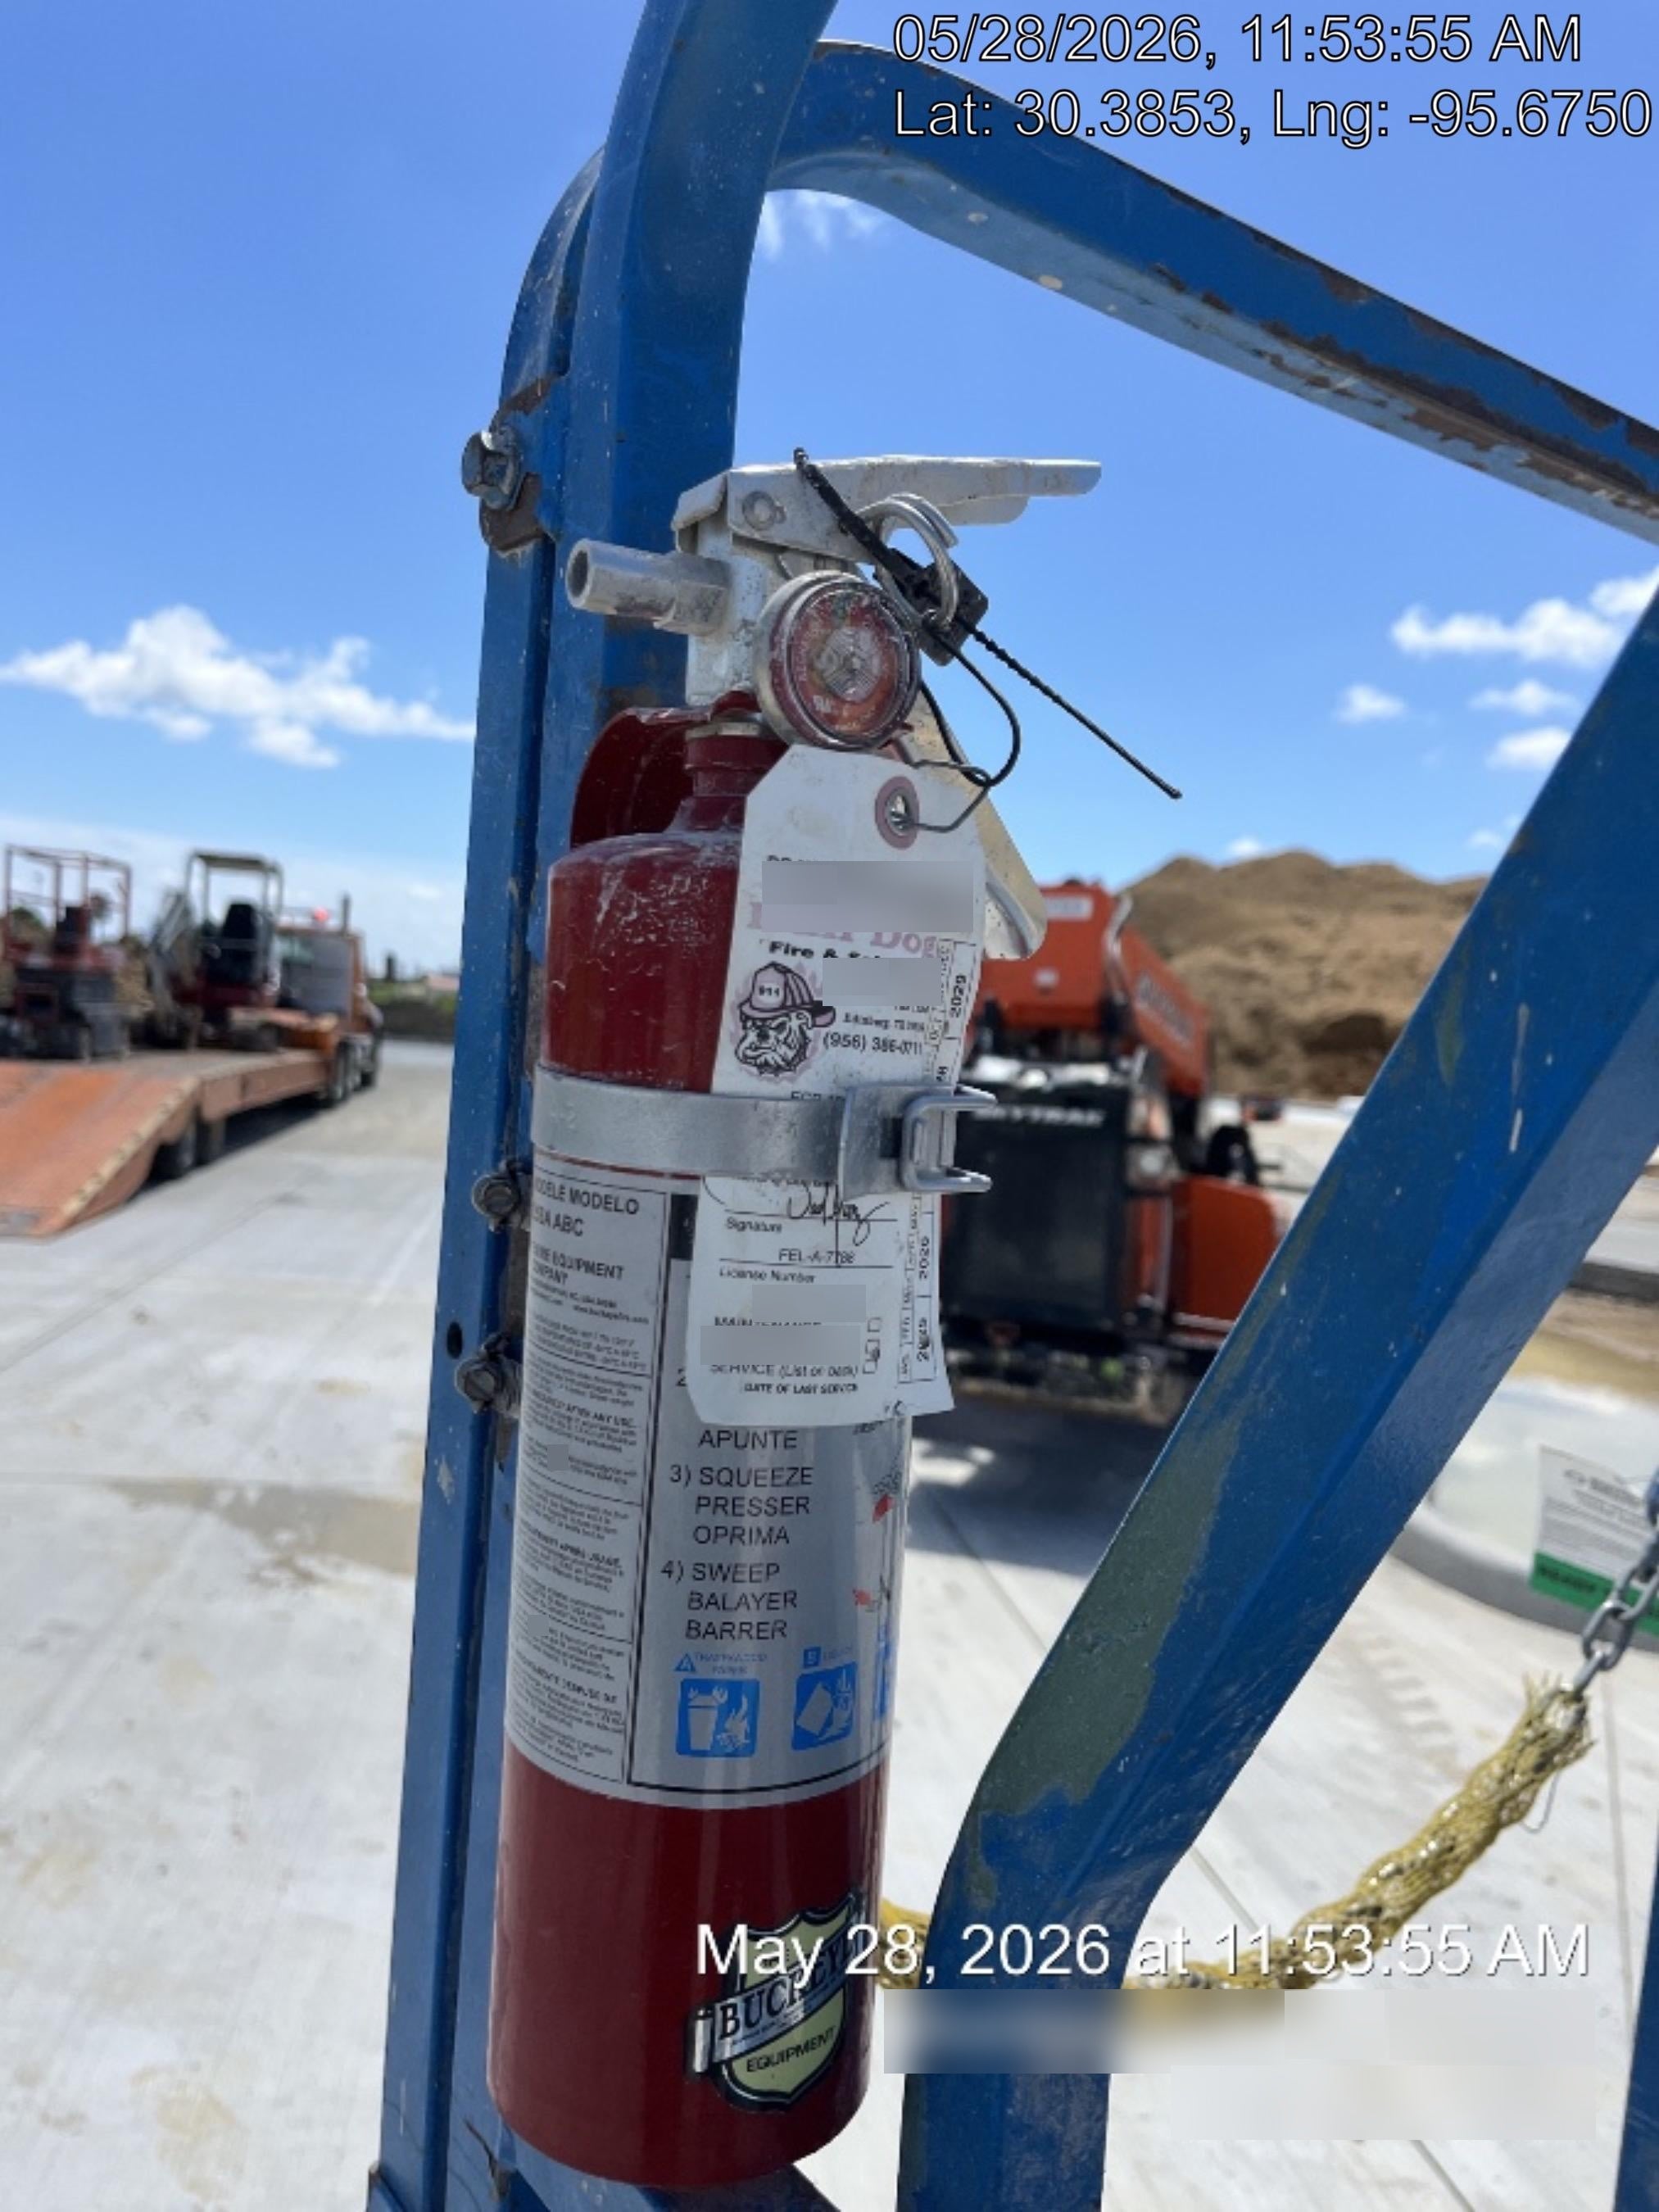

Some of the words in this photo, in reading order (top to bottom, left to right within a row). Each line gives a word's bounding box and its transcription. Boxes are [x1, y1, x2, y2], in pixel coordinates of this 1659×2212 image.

[769, 941, 814, 959] Fire
[823, 1031, 867, 1052] (956)
[569, 1186, 640, 1215] MODELO
[552, 1213, 583, 1237] ABC
[724, 1216, 782, 1233] Signature
[718, 1267, 768, 1281] License
[770, 1270, 816, 1284] Number
[698, 1429, 799, 1450] APUNTE
[669, 1464, 691, 1488] 3)
[699, 1466, 814, 1488] SQUEEZE
[695, 1495, 811, 1517] PRESSER
[693, 1525, 791, 1546] OPRIMA
[660, 1560, 684, 1584] 4)
[691, 1562, 780, 1583] SWEEP
[687, 1589, 798, 1611] BALAYER
[685, 1619, 788, 1640] BARRER
[746, 2024, 836, 2056] EQUIPMENT
